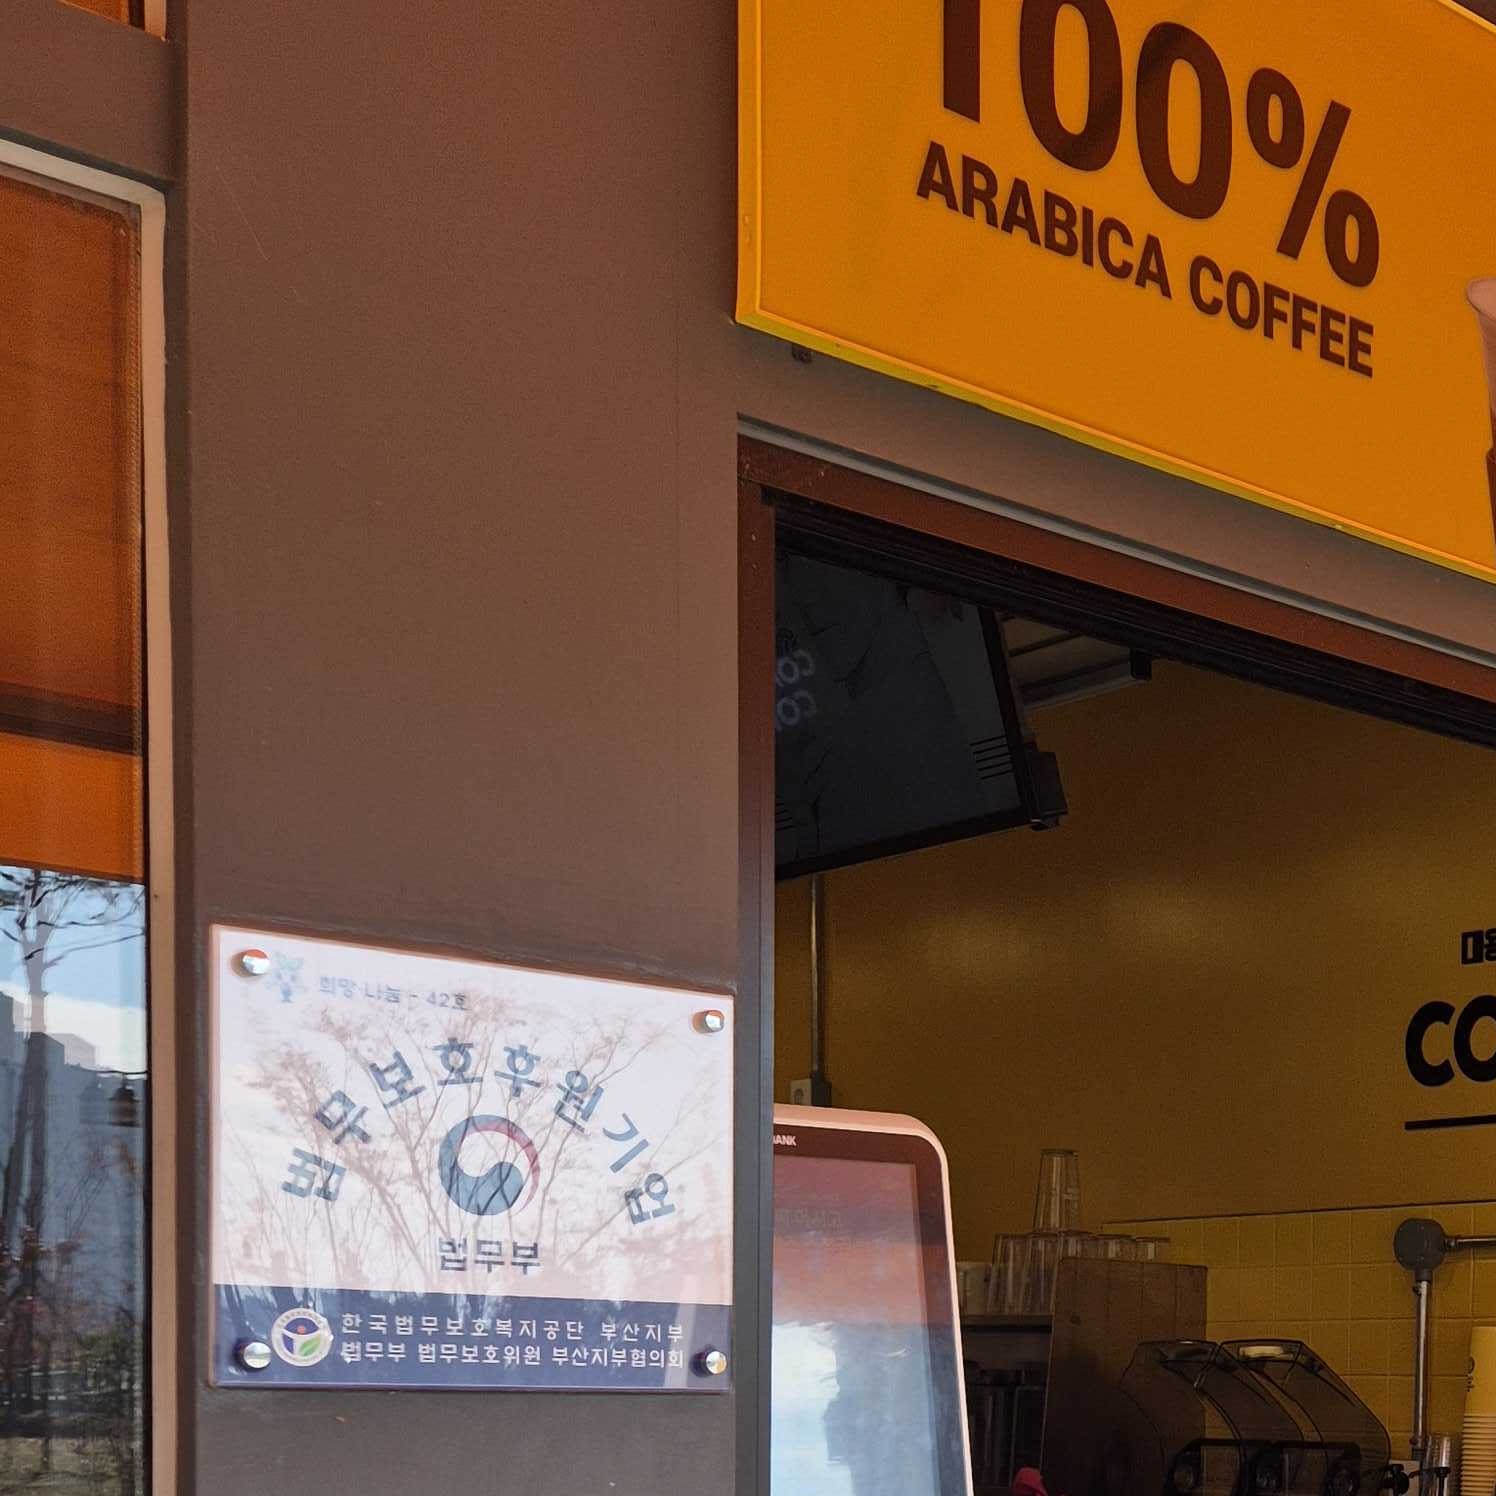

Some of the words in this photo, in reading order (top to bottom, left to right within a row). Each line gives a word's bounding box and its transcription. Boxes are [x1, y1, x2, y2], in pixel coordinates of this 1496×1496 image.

[942, 0, 1380, 287] 100%
[916, 141, 1171, 298] ARABICA
[1189, 256, 1374, 377] COFFEE
[281, 1036, 676, 1226] 법무보호후원기업
[438, 1237, 542, 1277] 법무부
[341, 1312, 585, 1341] 한국법무보호복지공단
[600, 1323, 684, 1342] 부산지부
[341, 1341, 406, 1363] 법무부
[418, 1342, 541, 1366] 법무보호위원
[551, 1346, 685, 1370] 부산지부협의회
